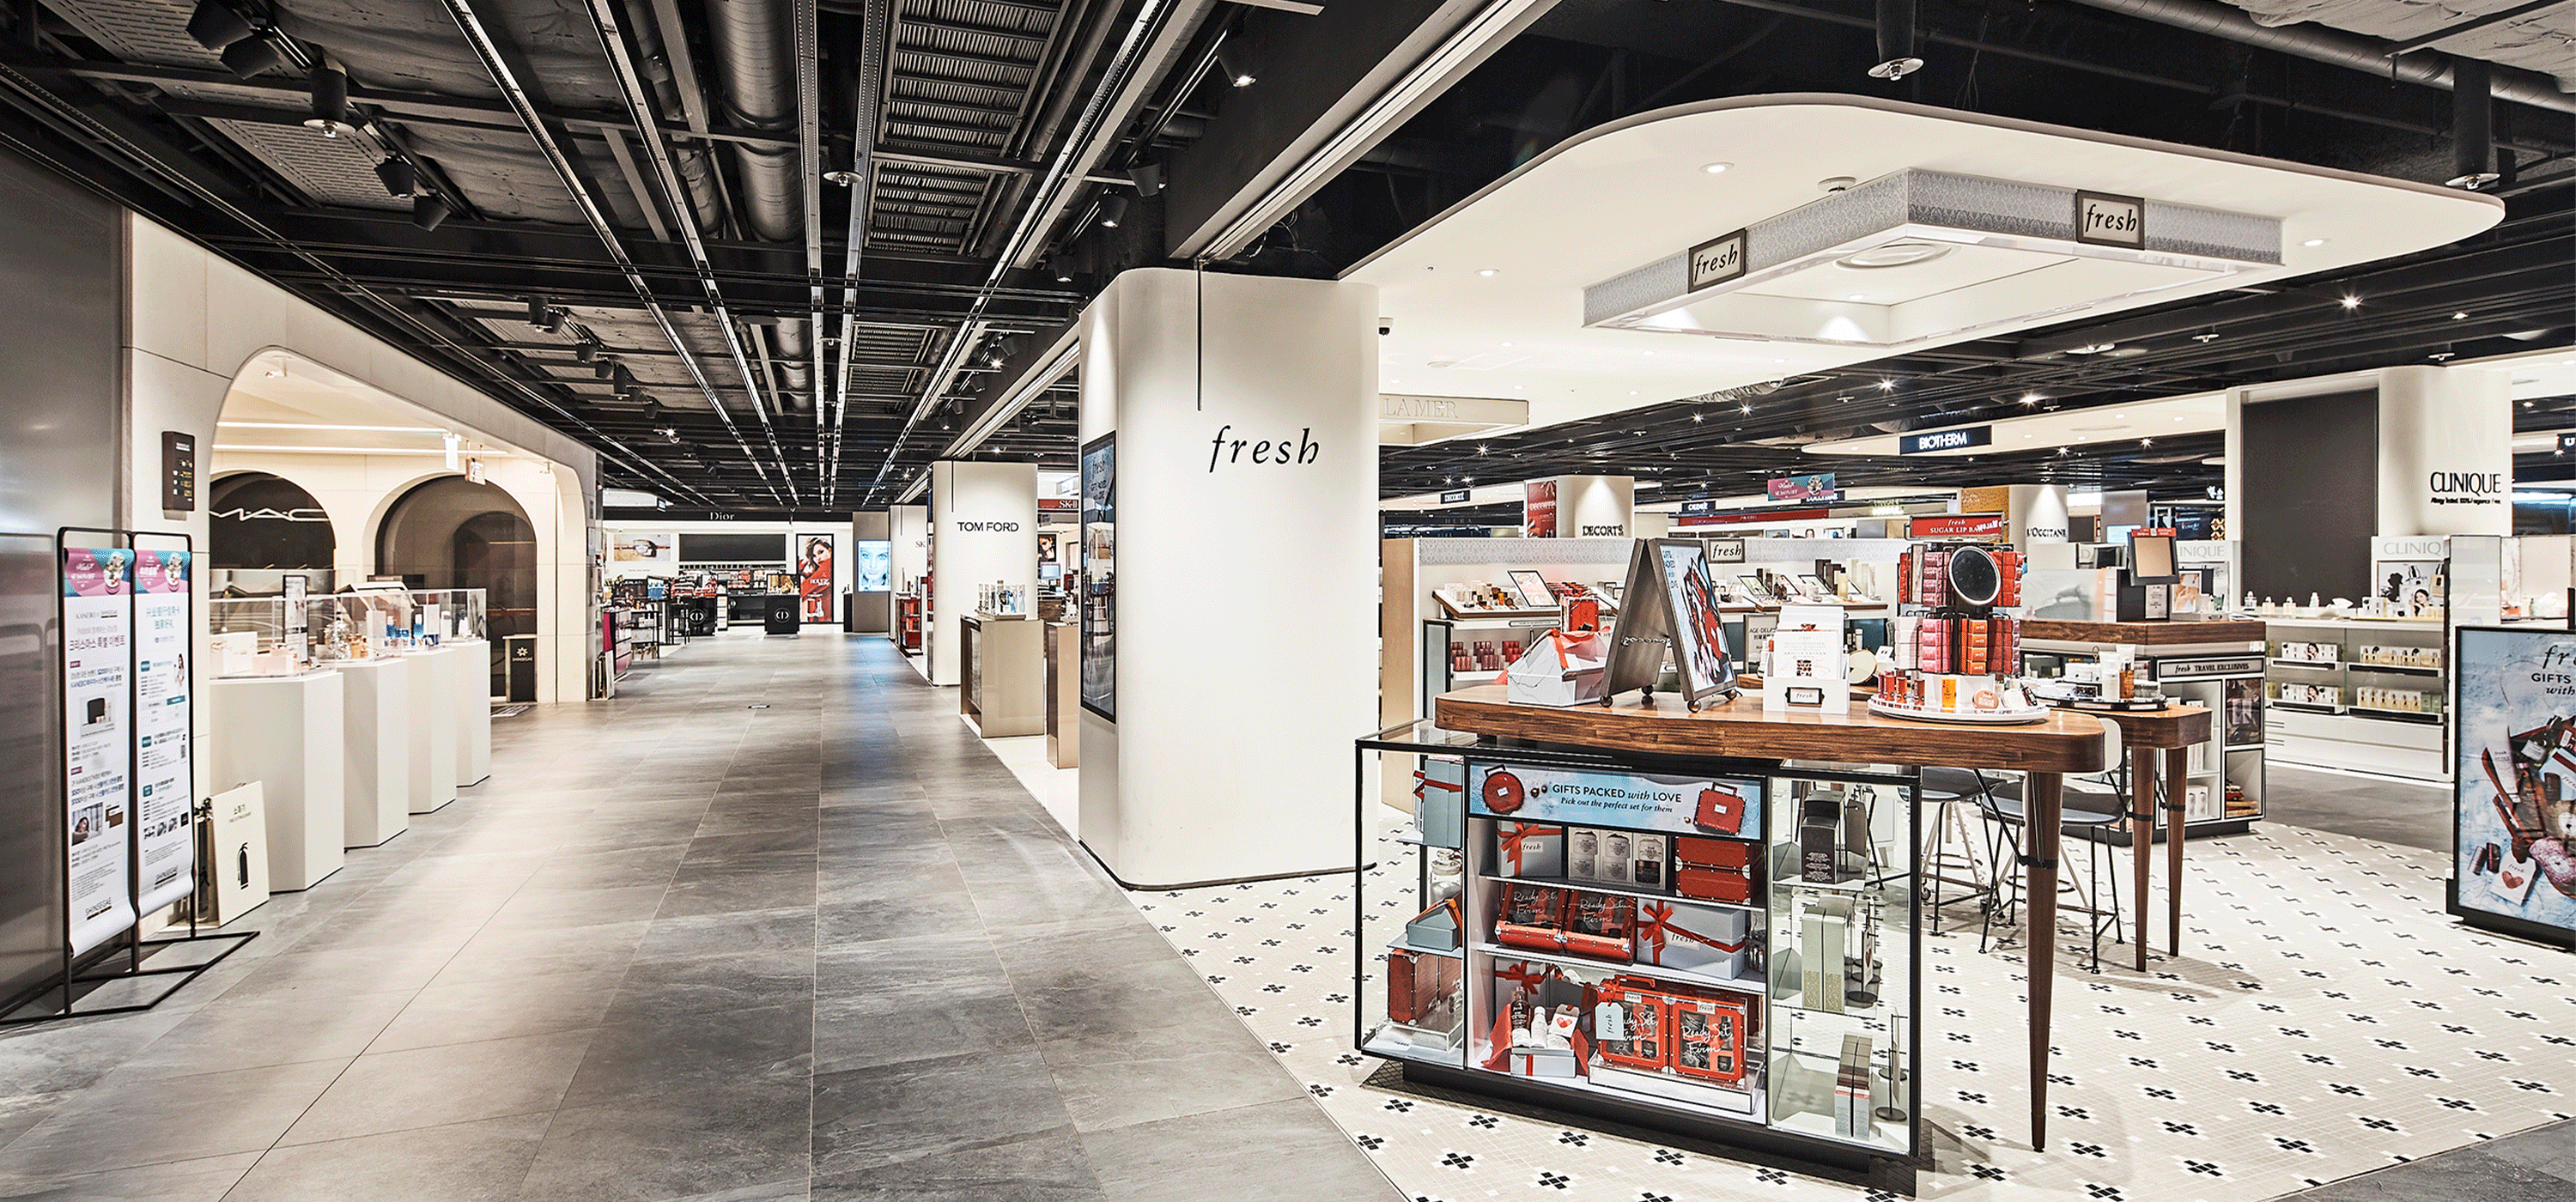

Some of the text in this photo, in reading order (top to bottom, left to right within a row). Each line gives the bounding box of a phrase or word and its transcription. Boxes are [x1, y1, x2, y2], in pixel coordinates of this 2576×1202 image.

[2086, 203, 2137, 233] fresh
[1694, 243, 1738, 282] fresh
[1383, 398, 1458, 419] LA MER
[1209, 425, 1320, 472] fresh
[1919, 431, 1968, 450] BIOTHERM
[2430, 471, 2501, 497] CLINIQUE
[710, 511, 736, 520] Dior
[957, 521, 1019, 532] TOM FORD
[1712, 543, 1742, 559] fresh
[2179, 545, 2225, 559] INIQUE
[2383, 541, 2441, 557] CLINIQ
[2174, 665, 2191, 675] fresh
[2217, 663, 2250, 671] EXCLUSIVES
[2530, 672, 2572, 684] GIFTS
[2546, 685, 2576, 695] with
[1552, 784, 1681, 803] GIFTS PACKED with LOVE
[1561, 797, 1576, 805] Pick
[1603, 801, 1628, 810] perfect
[1522, 841, 1541, 851] fresh
[1605, 1014, 1613, 1035] fresh
